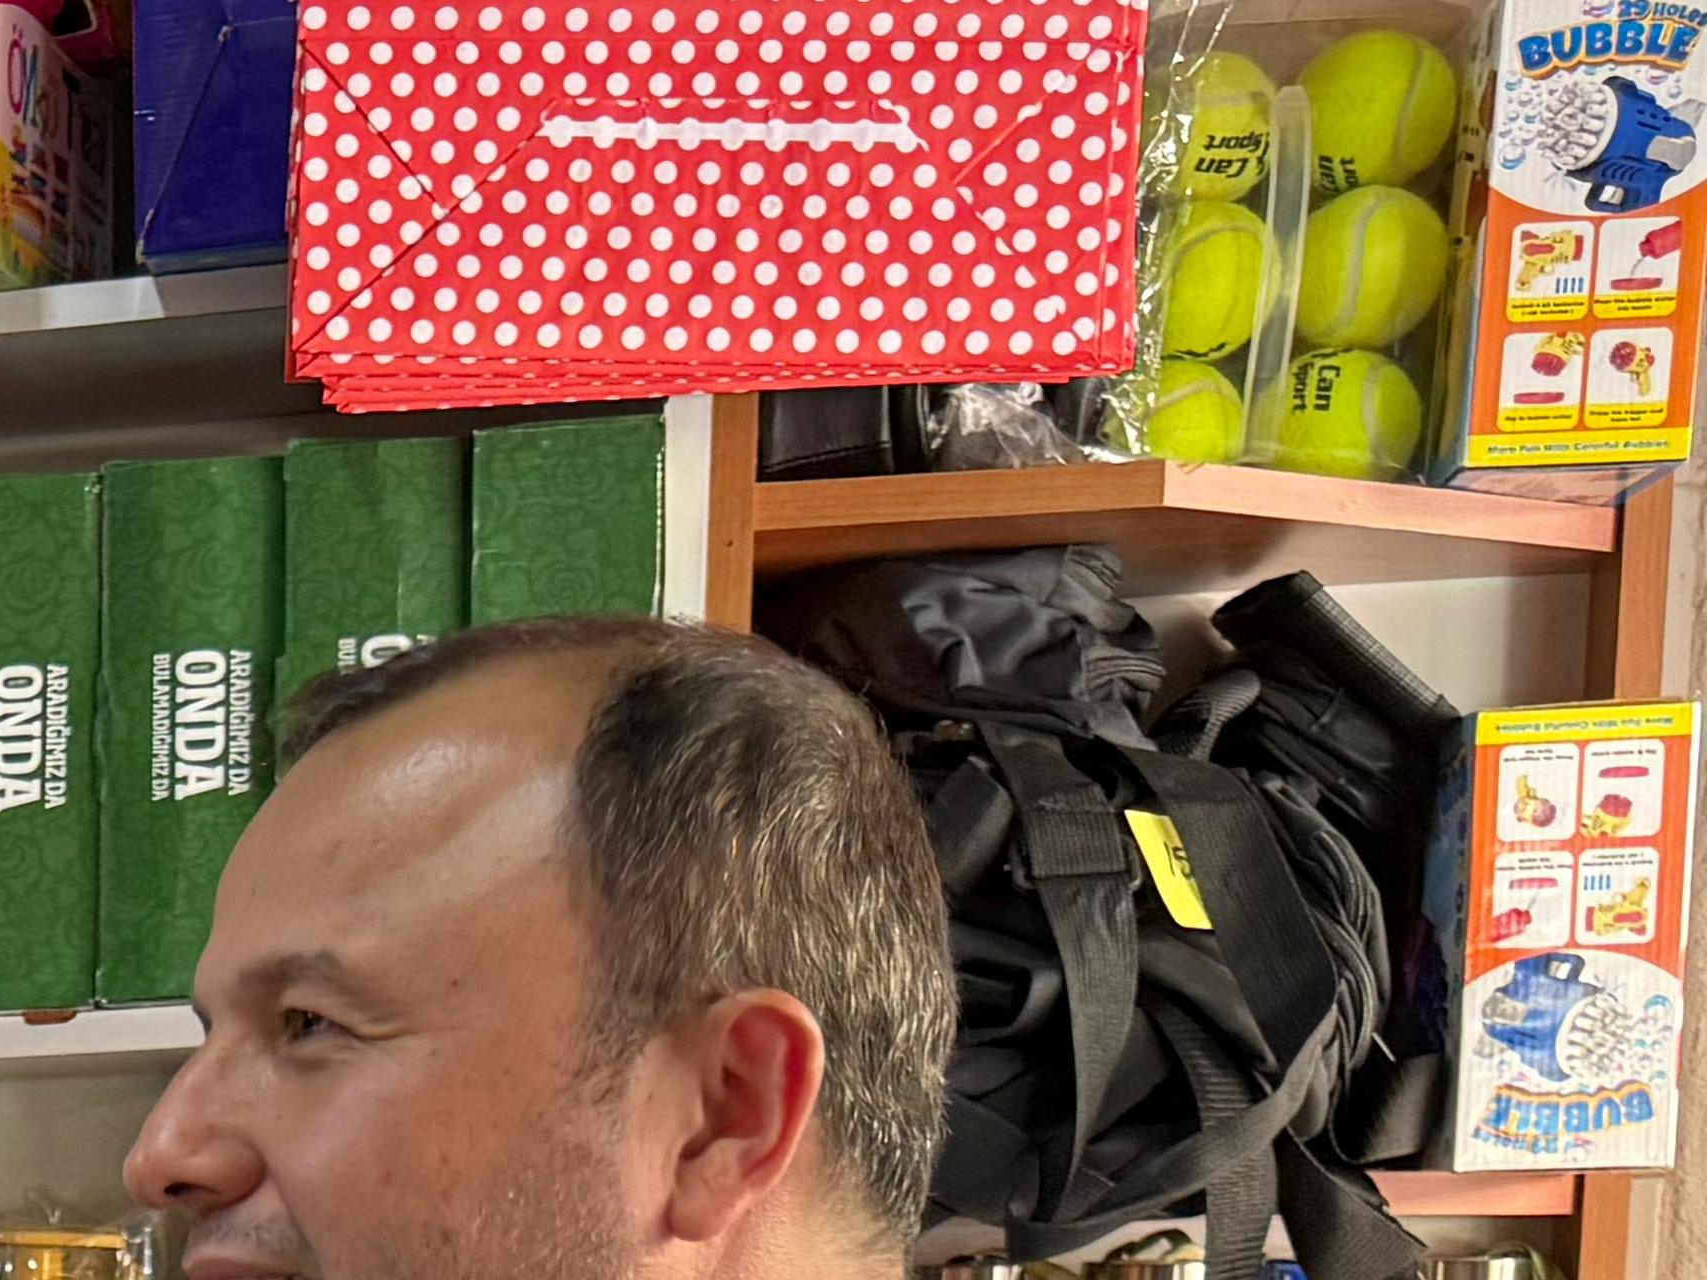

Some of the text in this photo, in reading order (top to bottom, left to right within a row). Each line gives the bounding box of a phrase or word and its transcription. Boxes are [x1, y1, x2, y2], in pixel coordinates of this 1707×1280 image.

[1517, 20, 1700, 72] BUBBLE
[1194, 157, 1249, 179] Can
[1313, 364, 1341, 413] Can
[44, 663, 70, 810] ARADIĞIMIZ DA
[150, 653, 172, 803] BULAMADIĞIMIZ DA
[173, 649, 228, 801] ONDA
[227, 648, 252, 796] ARADIĞIMIZ DA
[1482, 1090, 1656, 1138] BUBBLE
